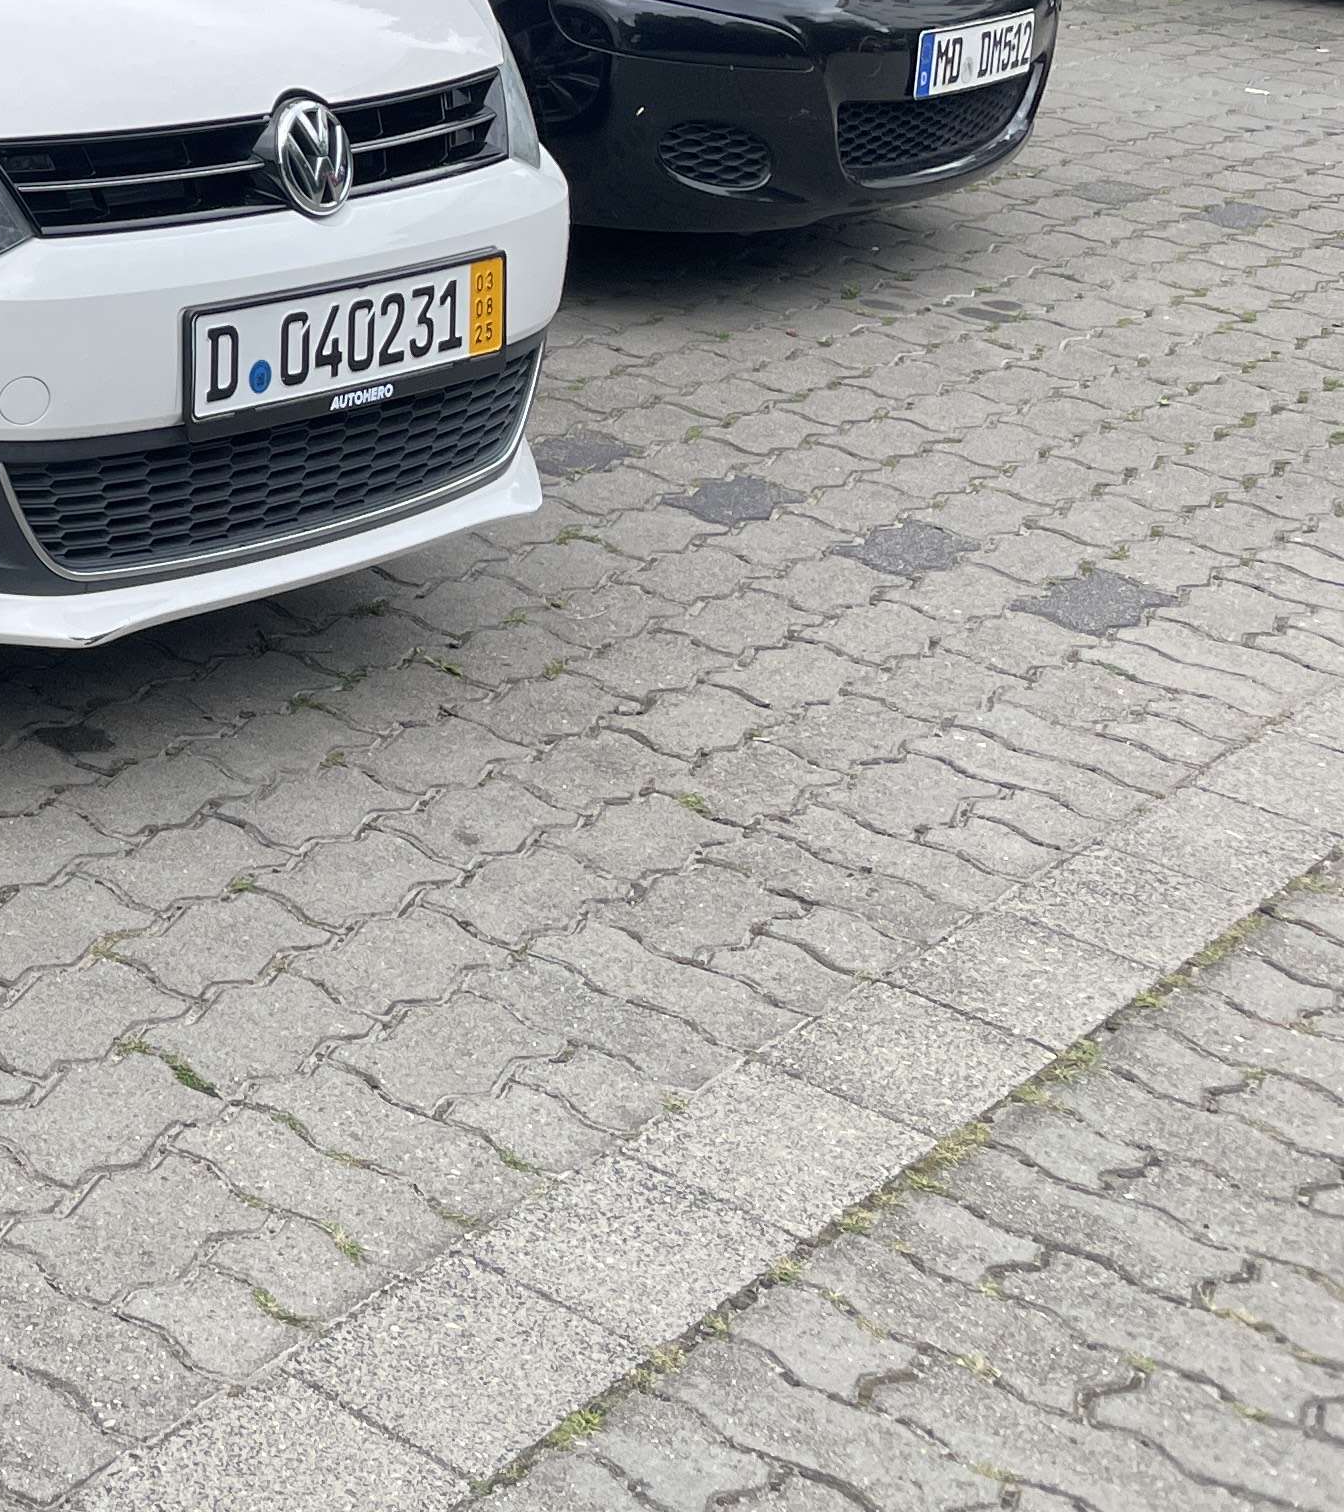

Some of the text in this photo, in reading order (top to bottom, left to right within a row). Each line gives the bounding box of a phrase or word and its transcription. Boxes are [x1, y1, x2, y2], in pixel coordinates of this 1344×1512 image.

[933, 20, 1032, 87] MD DM512
[476, 271, 494, 292] 03
[476, 297, 493, 318] 08
[206, 279, 463, 403] D 040231
[475, 321, 493, 344] 25
[329, 384, 394, 412] AUTOHERO
